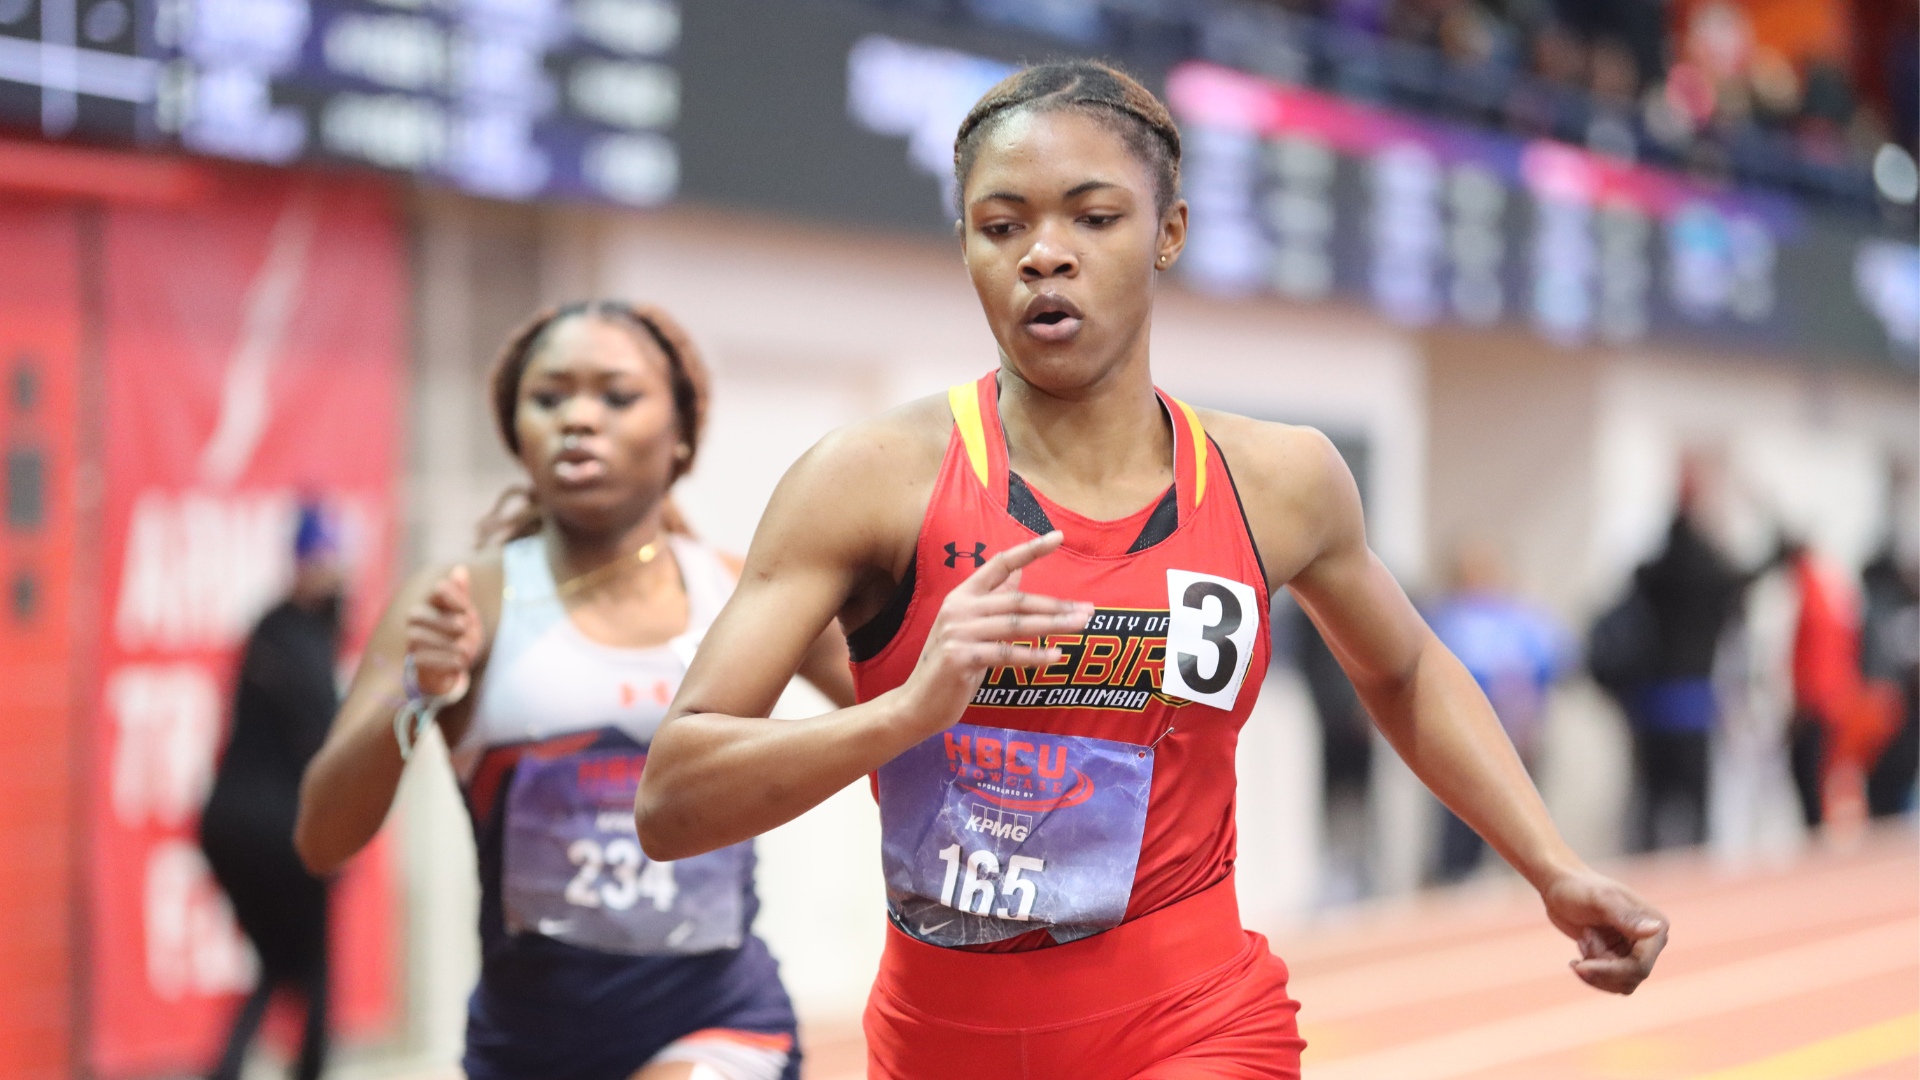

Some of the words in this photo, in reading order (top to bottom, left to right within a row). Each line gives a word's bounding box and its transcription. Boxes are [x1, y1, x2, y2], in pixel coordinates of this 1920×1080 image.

[1144, 616, 1170, 632] OF
[1177, 581, 1242, 694] 3
[988, 634, 1167, 689] REBIR
[972, 688, 1019, 704] RICT
[1017, 688, 1047, 705] OF
[1044, 687, 1150, 708] COLUMBIA
[943, 732, 1068, 779] HBCU
[949, 761, 1063, 793] SHOWCASE
[965, 814, 1029, 842] KPMG
[565, 838, 679, 912] 234
[939, 843, 1047, 921] 165
